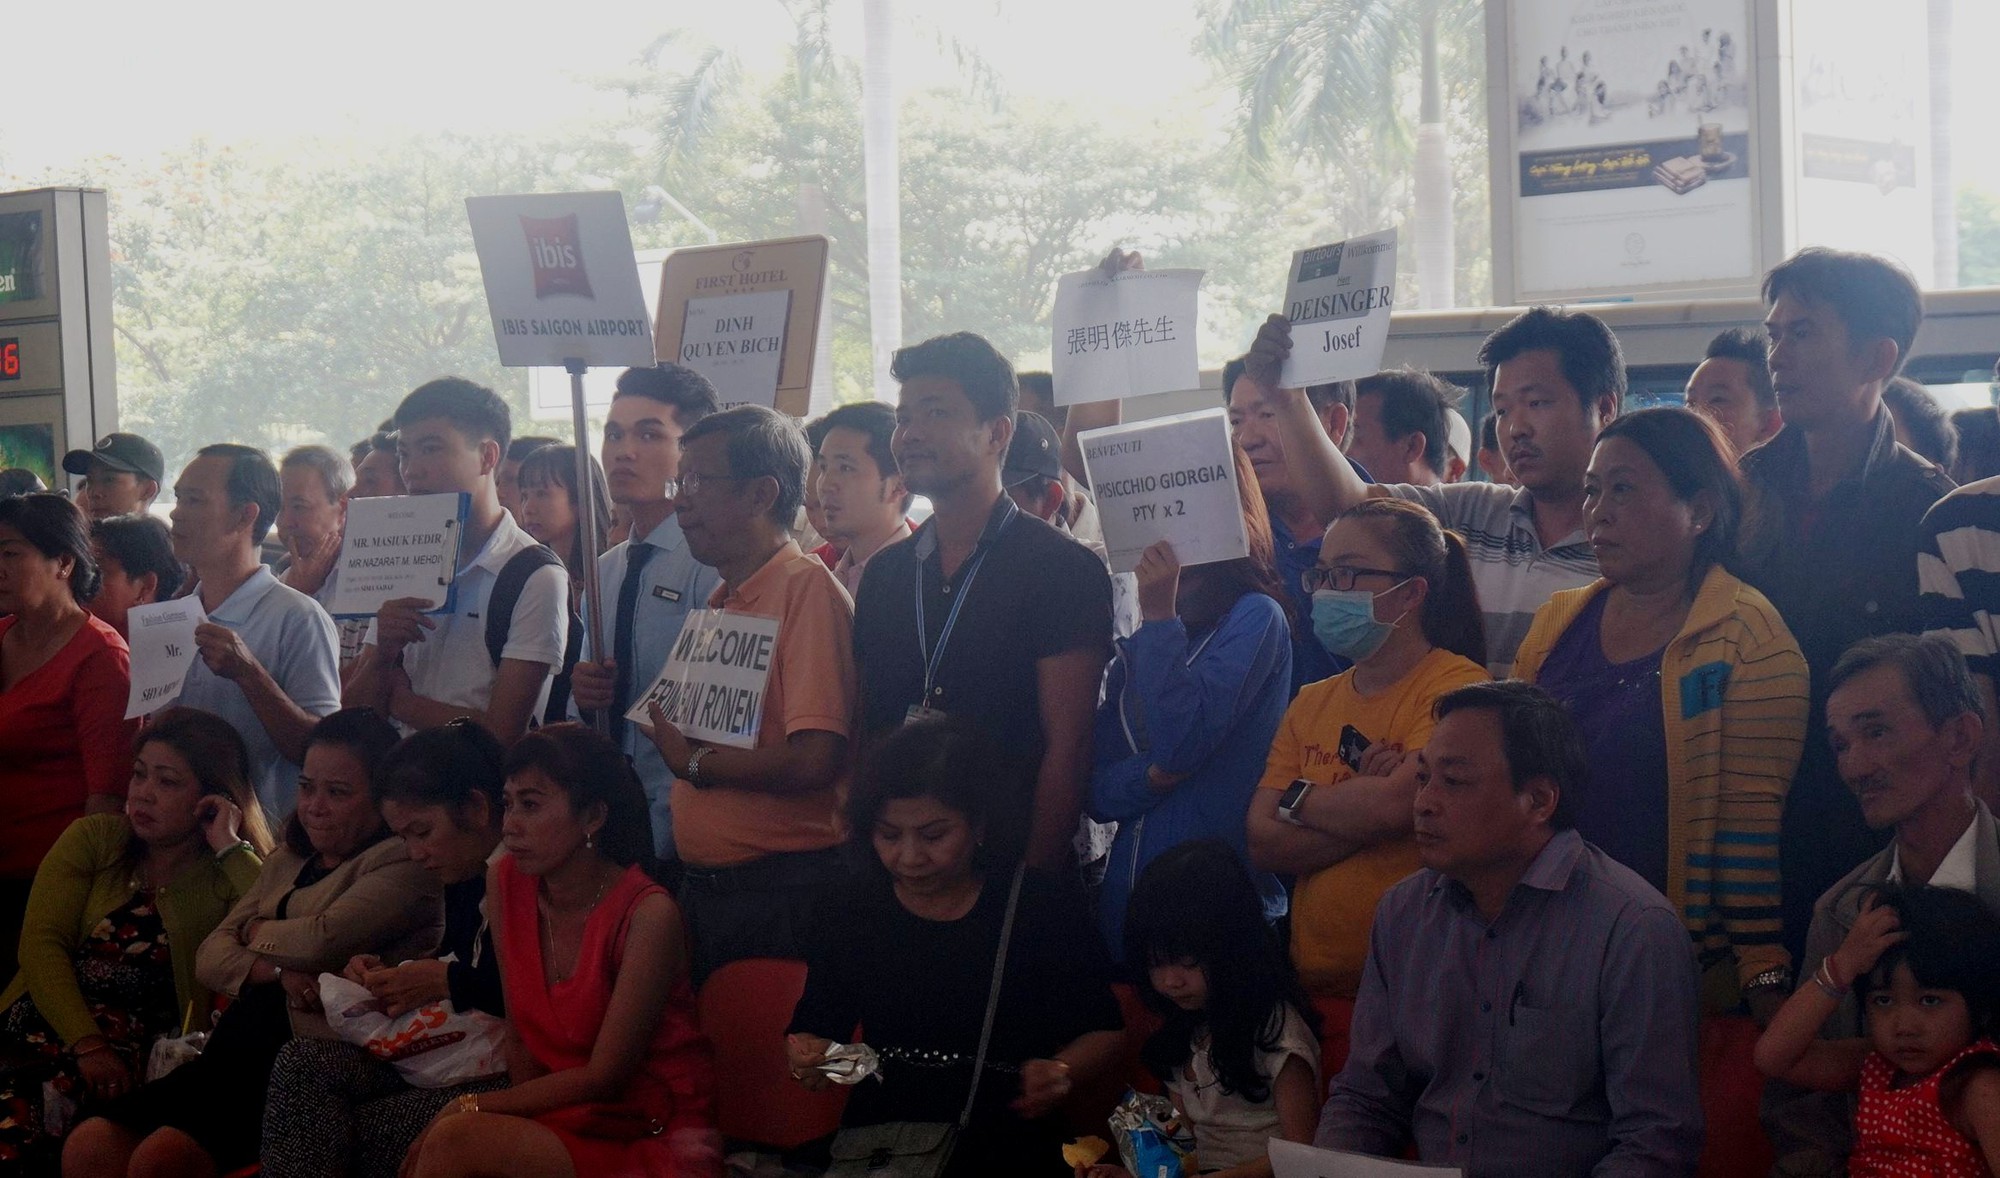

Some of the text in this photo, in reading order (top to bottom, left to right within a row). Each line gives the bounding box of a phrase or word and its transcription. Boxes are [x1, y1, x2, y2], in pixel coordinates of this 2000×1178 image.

[533, 237, 576, 269] ibis
[696, 269, 788, 290] FIRST HOTEL
[502, 319, 644, 336] IBIS SAIGON AIRPORT
[715, 316, 753, 333] DINH
[1067, 315, 1176, 355] 張明傑先生
[683, 337, 779, 361] QUYEN BICH
[1322, 325, 1362, 352] Josef
[1097, 465, 1227, 499] PISICCHIO GIORGIA
[1133, 505, 1156, 522] PTY
[1176, 500, 1186, 515] 2
[372, 535, 410, 546] MASIUK
[411, 533, 442, 545] FEDIR
[165, 644, 182, 657] Mr.
[675, 628, 773, 671] WELCOME
[699, 684, 759, 736] RONEN
